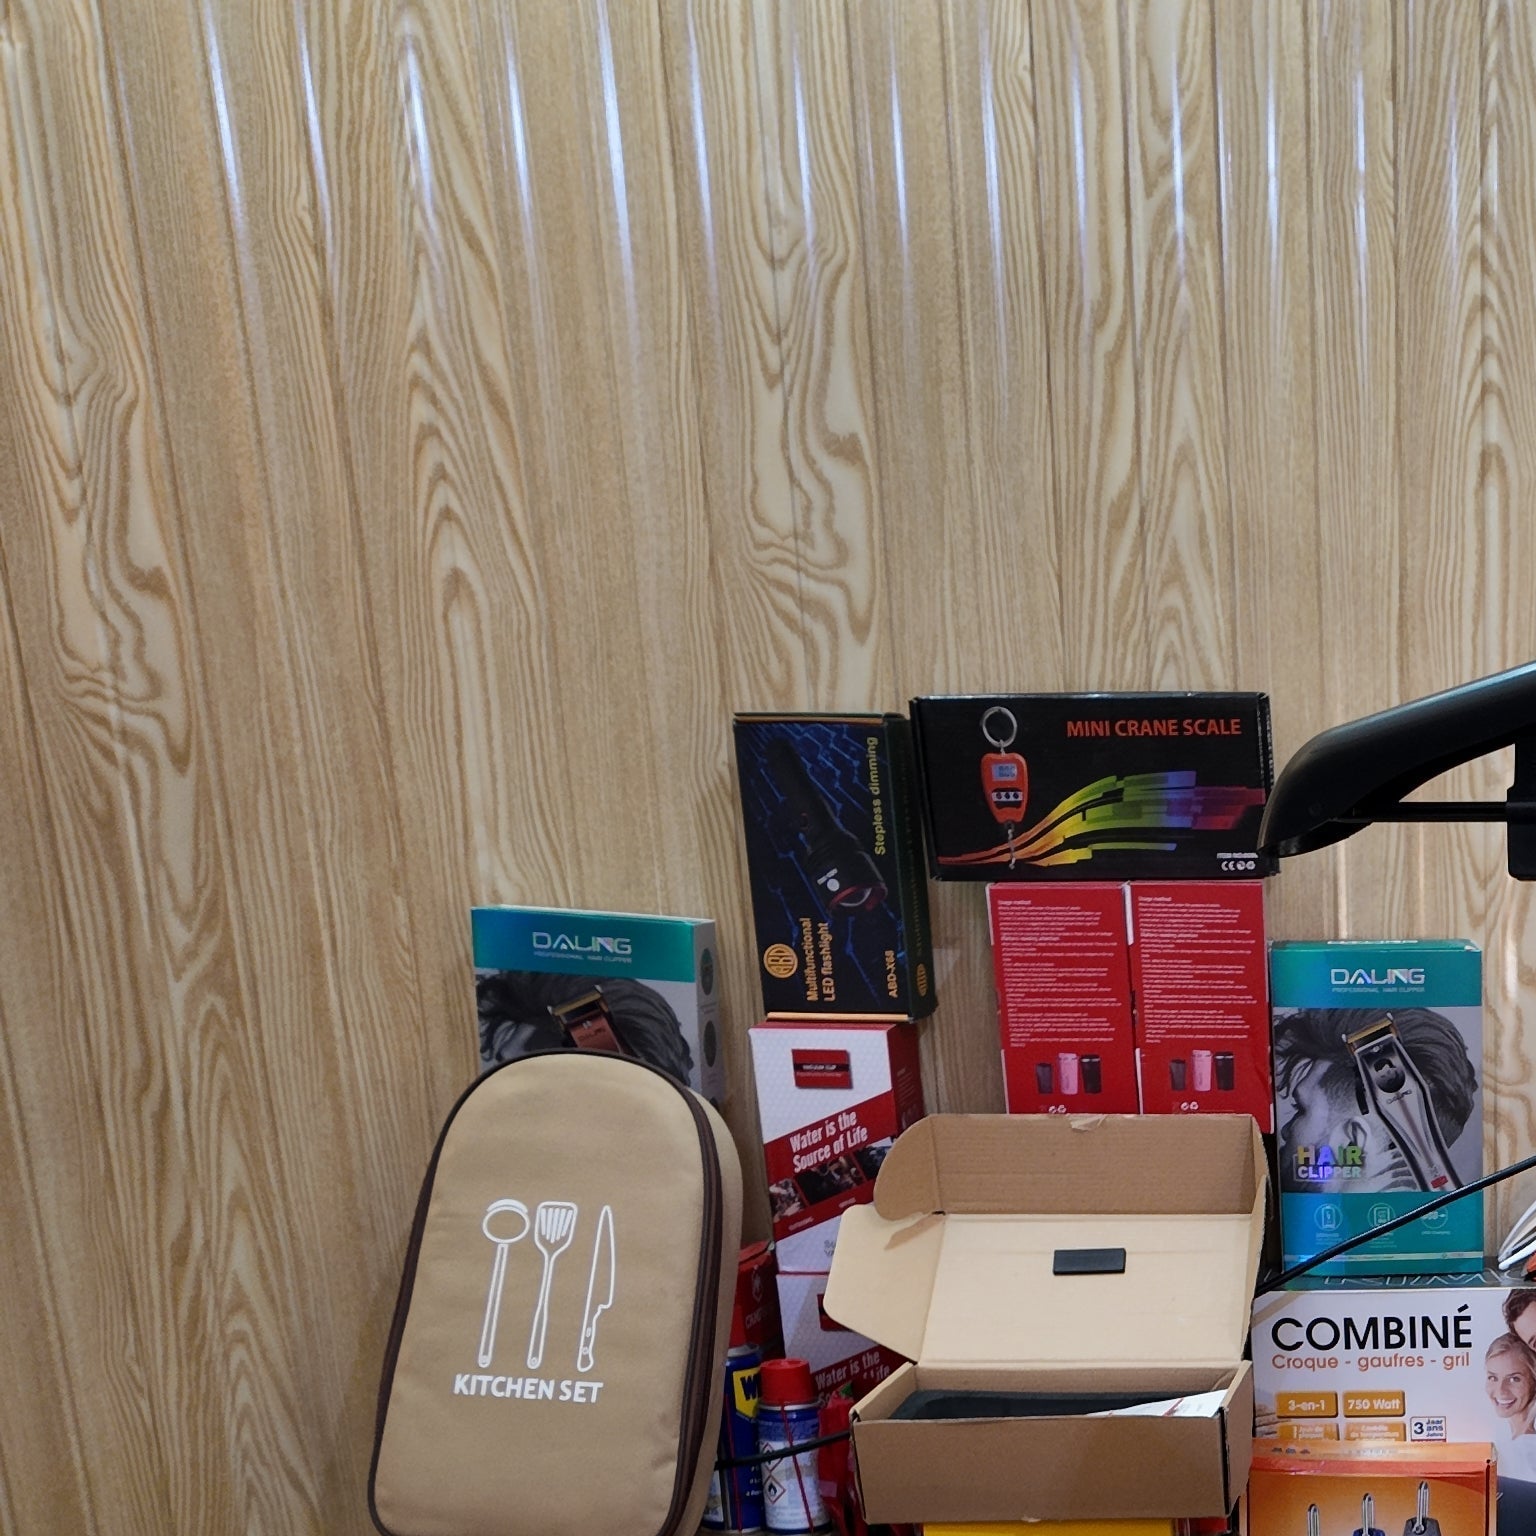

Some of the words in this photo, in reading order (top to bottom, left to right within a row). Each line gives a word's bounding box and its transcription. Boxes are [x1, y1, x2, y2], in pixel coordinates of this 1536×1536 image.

[1066, 720, 1111, 738] MINI
[1115, 719, 1179, 737] CRANE
[1183, 718, 1243, 736] SCALE
[866, 736, 880, 794] dimming
[873, 799, 886, 855] Stepless
[532, 931, 632, 955] DALING
[817, 922, 835, 976] flashlight
[800, 917, 819, 1002] Multifunctional
[1330, 968, 1425, 985] DALING
[821, 979, 837, 1002] LED
[789, 1127, 823, 1154] Water
[825, 1119, 836, 1137] is
[838, 1111, 857, 1132] the
[792, 1146, 831, 1174] Source
[833, 1135, 845, 1156] of
[846, 1124, 868, 1147] Life
[1296, 1145, 1363, 1165] HAIR
[1297, 1165, 1362, 1180] CLIPPER
[1271, 1303, 1473, 1352] COMBINÉ
[815, 1364, 848, 1391] Water
[849, 1358, 860, 1376] is
[861, 1351, 881, 1371] the
[1271, 1354, 1339, 1372] Croque
[1357, 1352, 1425, 1372] gaufres
[1442, 1351, 1470, 1371] gril
[453, 1373, 556, 1401] KITCHEN
[558, 1379, 604, 1403] SET
[1287, 1399, 1326, 1411] 3-en-1
[1347, 1399, 1371, 1410] 750
[1372, 1399, 1400, 1410] Watt
[1413, 1421, 1425, 1435] 3
